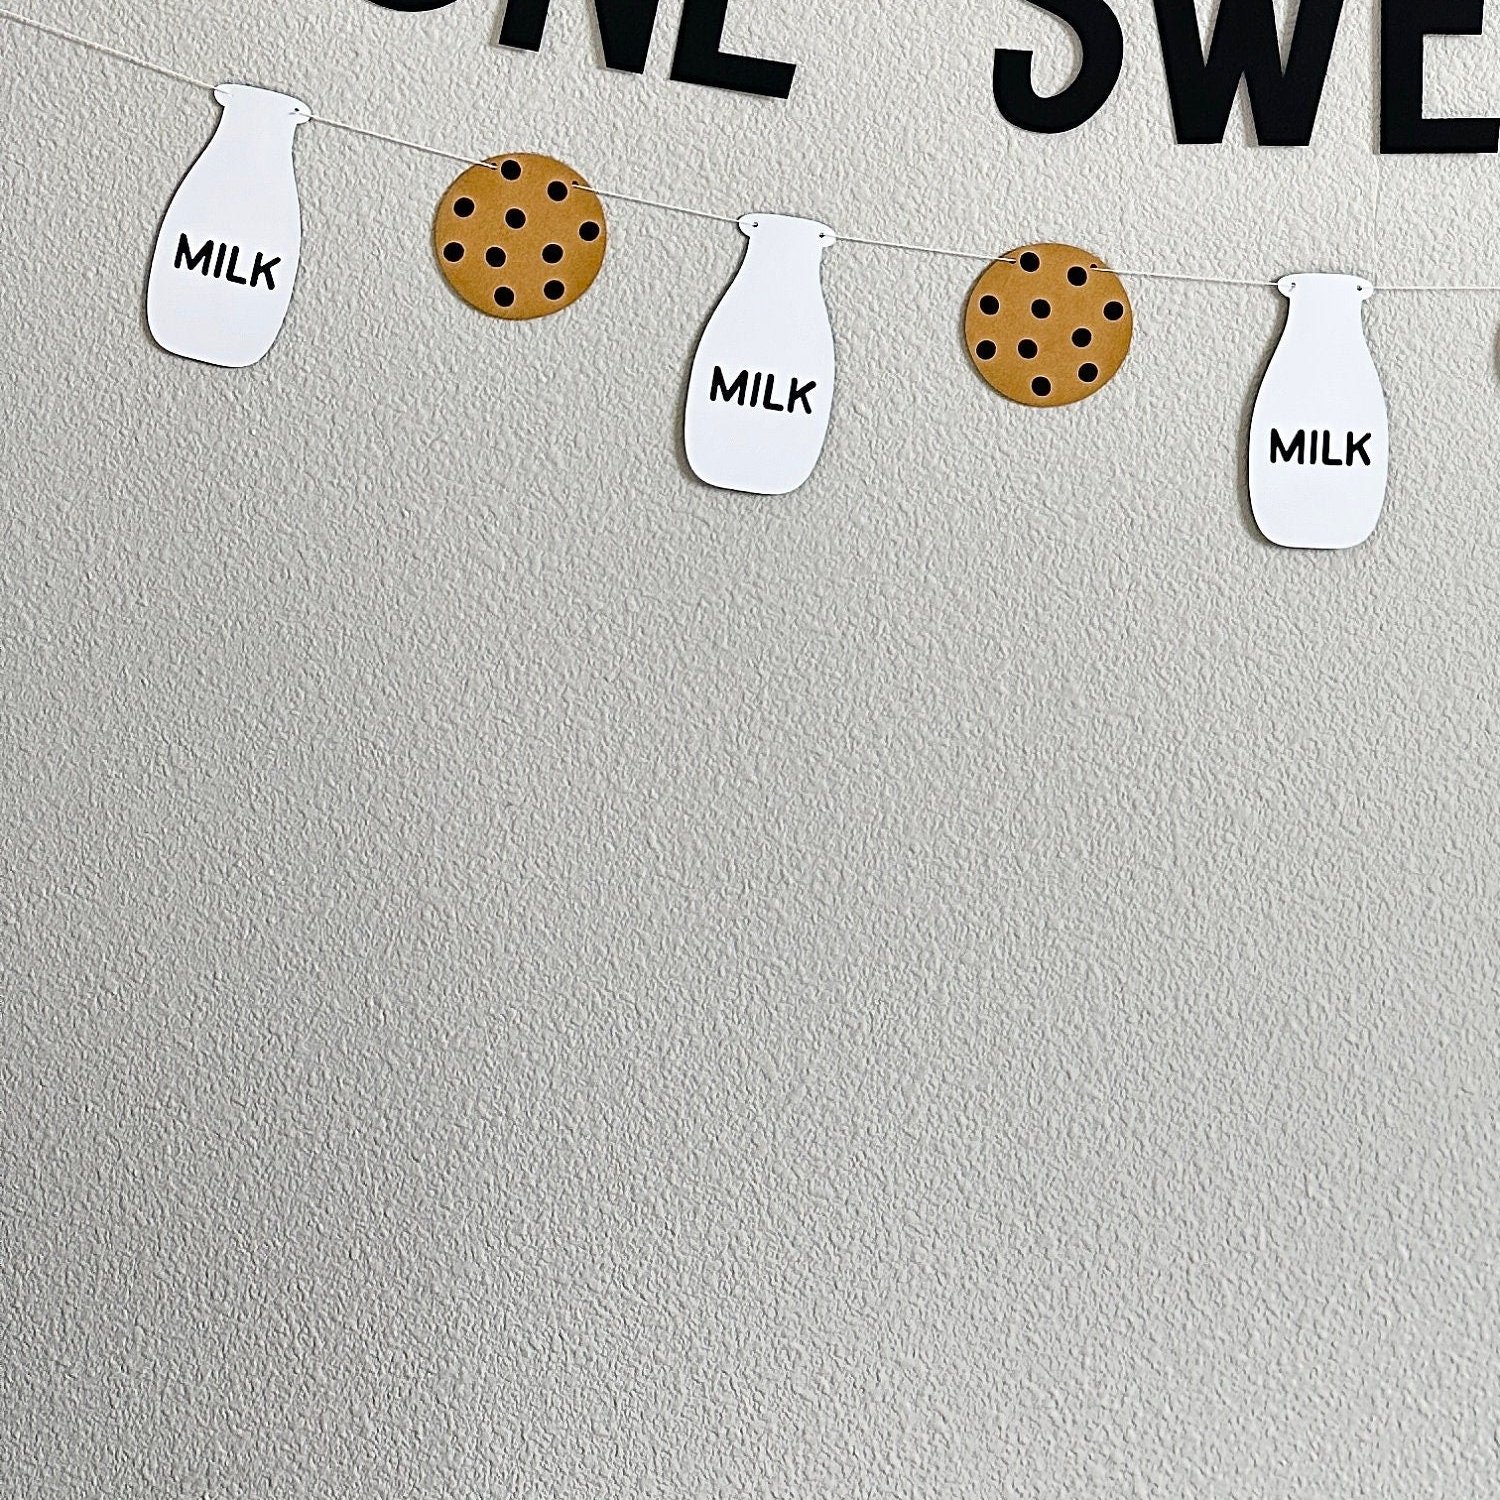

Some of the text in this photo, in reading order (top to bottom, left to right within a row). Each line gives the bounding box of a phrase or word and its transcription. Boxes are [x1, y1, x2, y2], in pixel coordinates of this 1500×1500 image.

[173, 232, 282, 291] MILK
[709, 365, 817, 415] MILK
[1269, 427, 1372, 467] MILK
